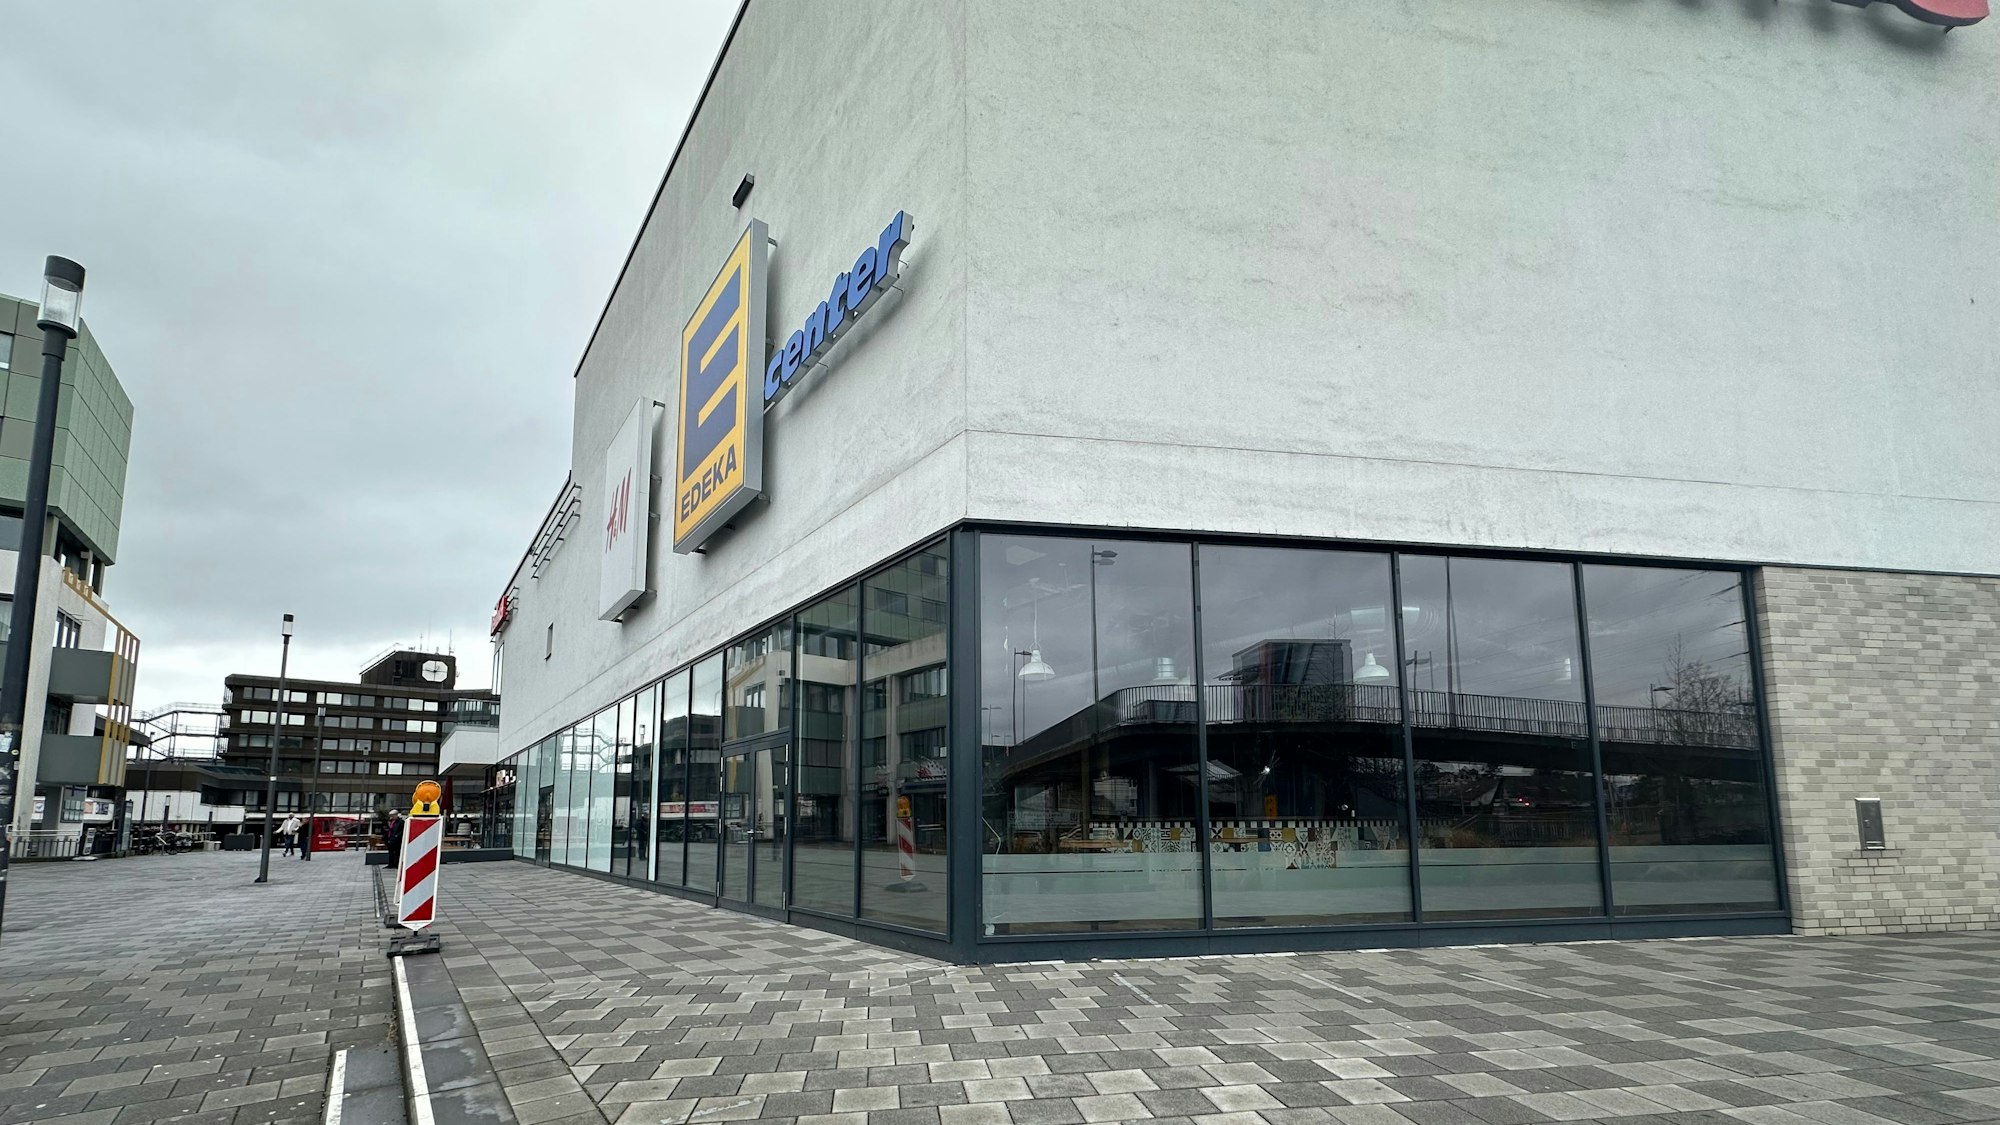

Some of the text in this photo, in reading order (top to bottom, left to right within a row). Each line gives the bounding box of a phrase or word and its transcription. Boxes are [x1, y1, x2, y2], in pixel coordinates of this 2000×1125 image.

[764, 210, 904, 401] center
[605, 466, 632, 555] H&M
[680, 442, 738, 524] EDEKA
